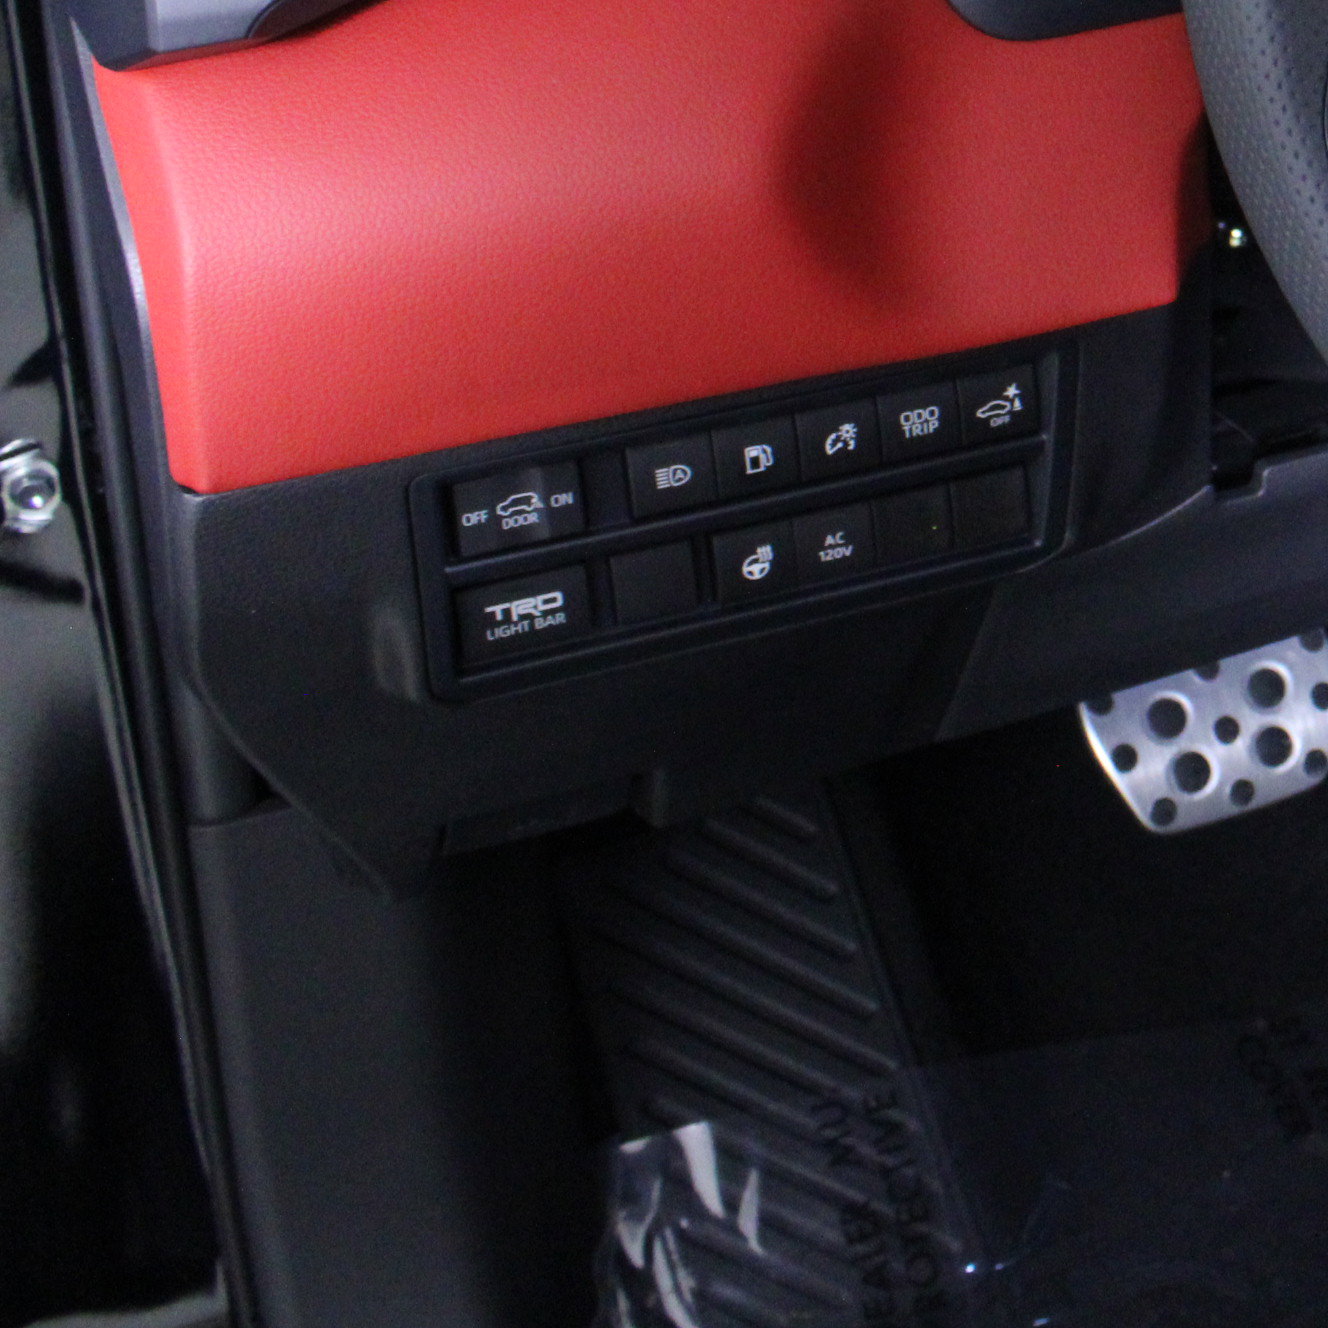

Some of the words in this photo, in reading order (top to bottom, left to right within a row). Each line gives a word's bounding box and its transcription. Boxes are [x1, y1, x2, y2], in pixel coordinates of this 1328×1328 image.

[900, 406, 939, 426] ODO
[902, 420, 939, 439] TRIP
[550, 492, 574, 508] ON
[462, 510, 488, 527] OFF
[502, 513, 539, 530] DOOR
[824, 532, 846, 547] AC
[818, 544, 854, 563] 120V
[484, 592, 564, 621] TRD
[486, 619, 531, 641] LIGHT
[534, 612, 567, 630] BAR
